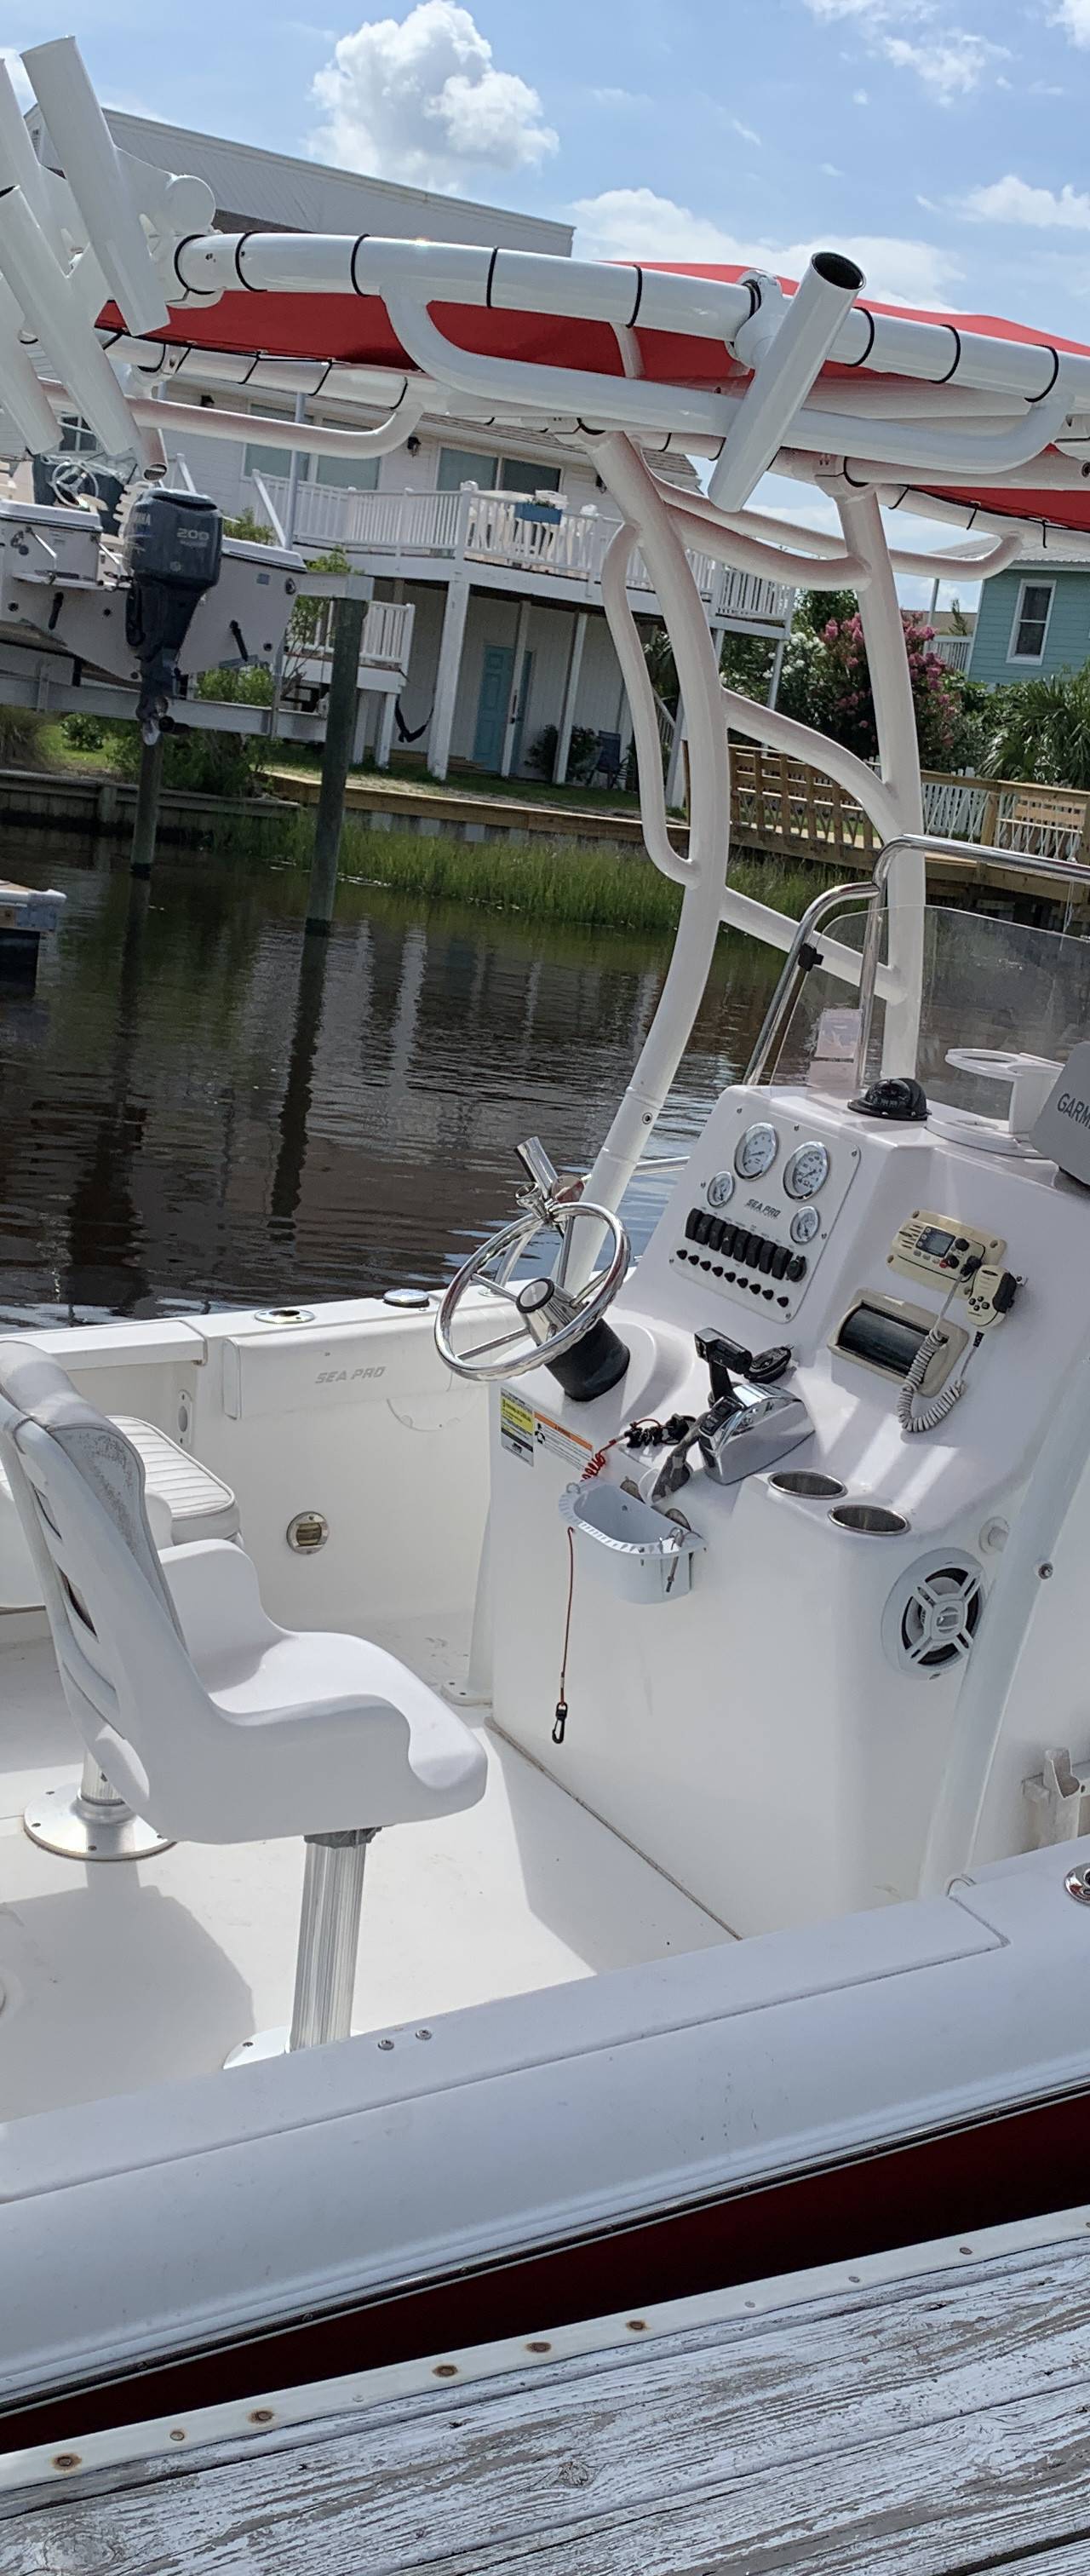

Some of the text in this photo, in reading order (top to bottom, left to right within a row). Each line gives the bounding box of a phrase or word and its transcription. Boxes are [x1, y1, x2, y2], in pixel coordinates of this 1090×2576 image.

[177, 528, 209, 541] 200
[1058, 1093, 1090, 1130] GARM
[746, 1199, 781, 1218] SEA PRO
[315, 1366, 387, 1383] SEA PRO
